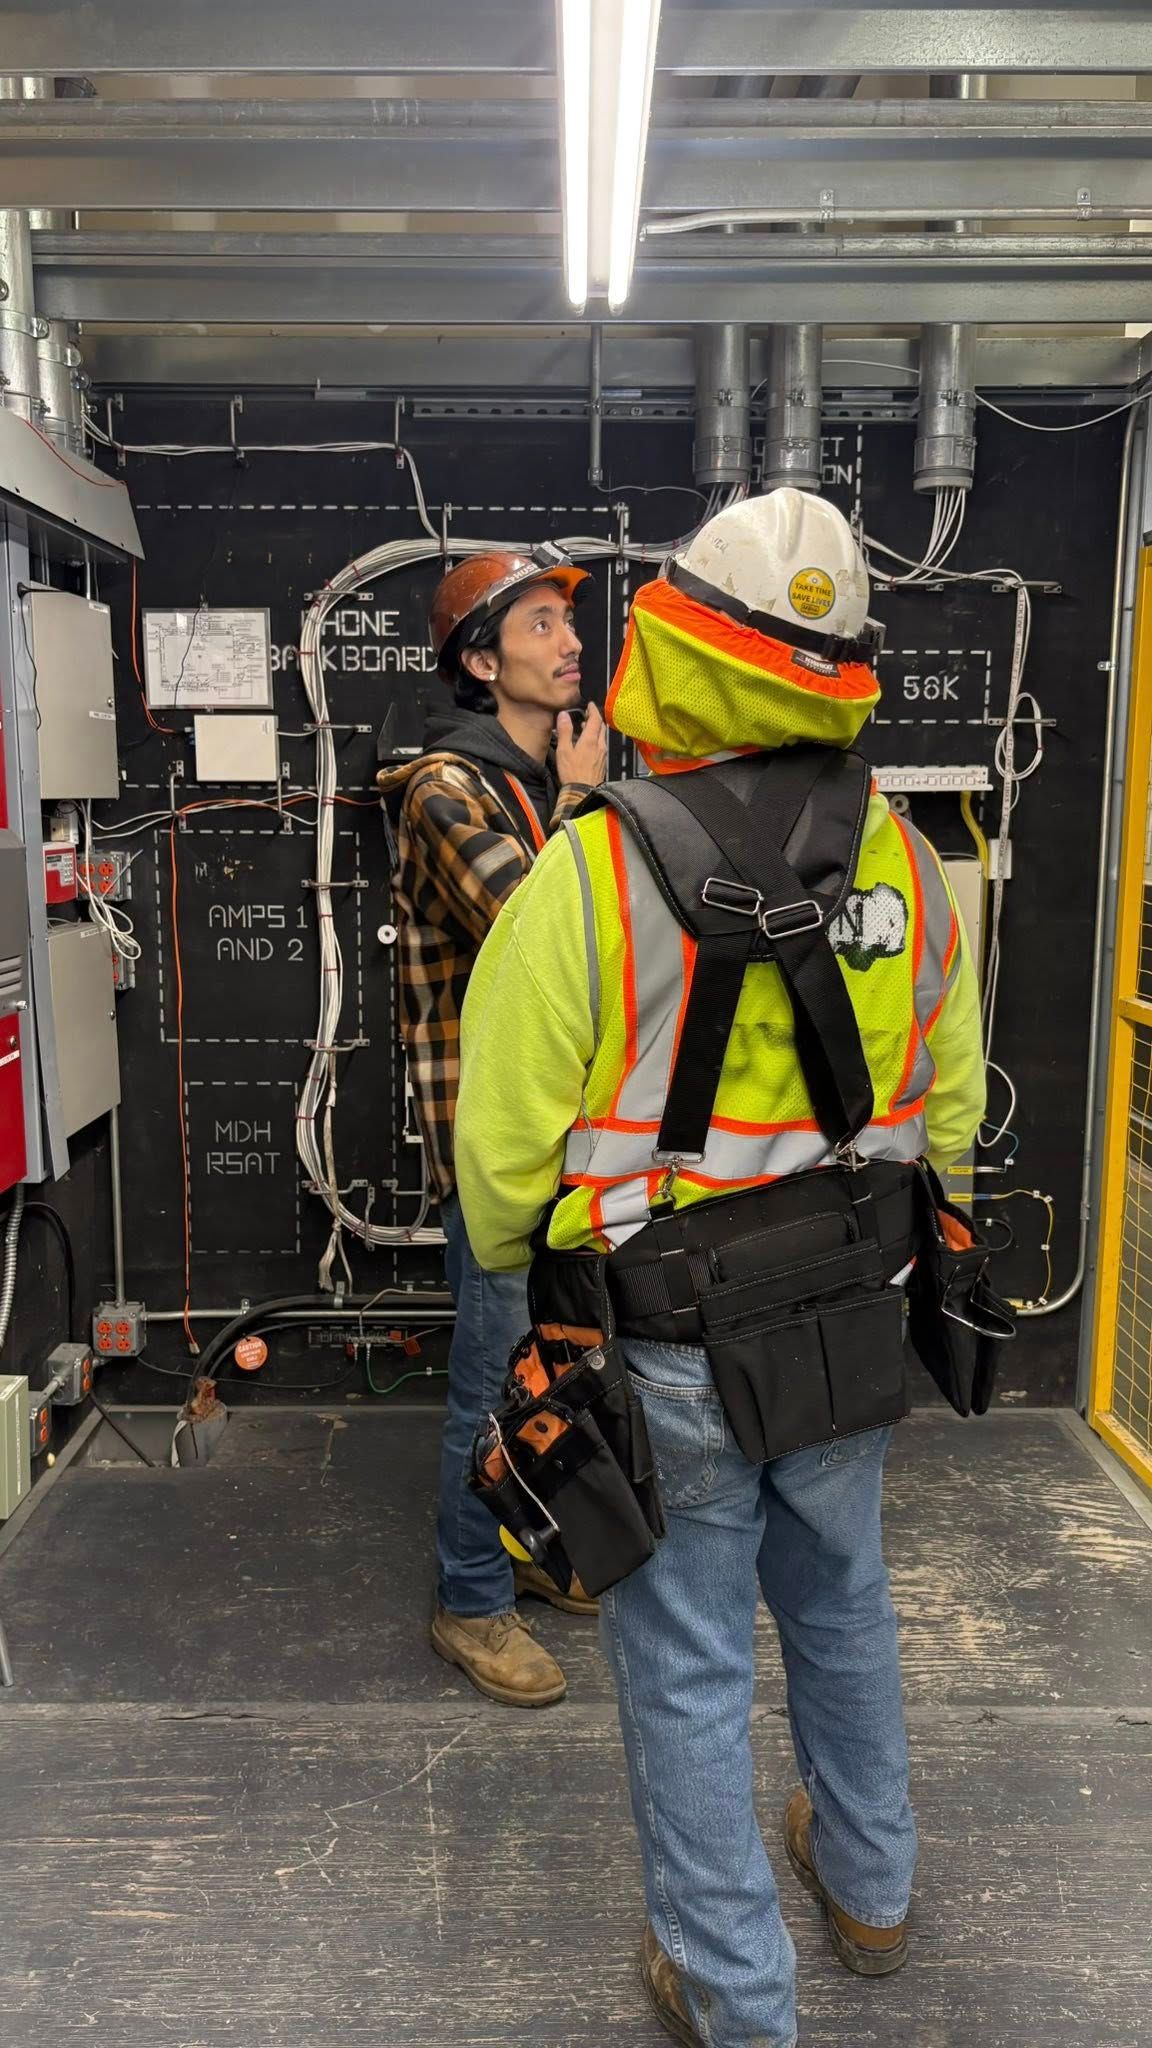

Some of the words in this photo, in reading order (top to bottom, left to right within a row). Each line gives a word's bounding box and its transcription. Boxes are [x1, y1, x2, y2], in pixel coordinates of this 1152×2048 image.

[792, 593, 811, 602] SAVE
[795, 583, 814, 592] TAKE
[815, 586, 832, 597] TIME
[271, 645, 438, 672] BAKBOARD
[903, 675, 960, 700] 56K
[209, 904, 286, 928] AMPS
[296, 905, 309, 928] 1
[217, 938, 274, 961] AND
[287, 938, 304, 961] 2
[215, 1120, 271, 1143] MDH
[206, 1152, 281, 1175] RSAT
